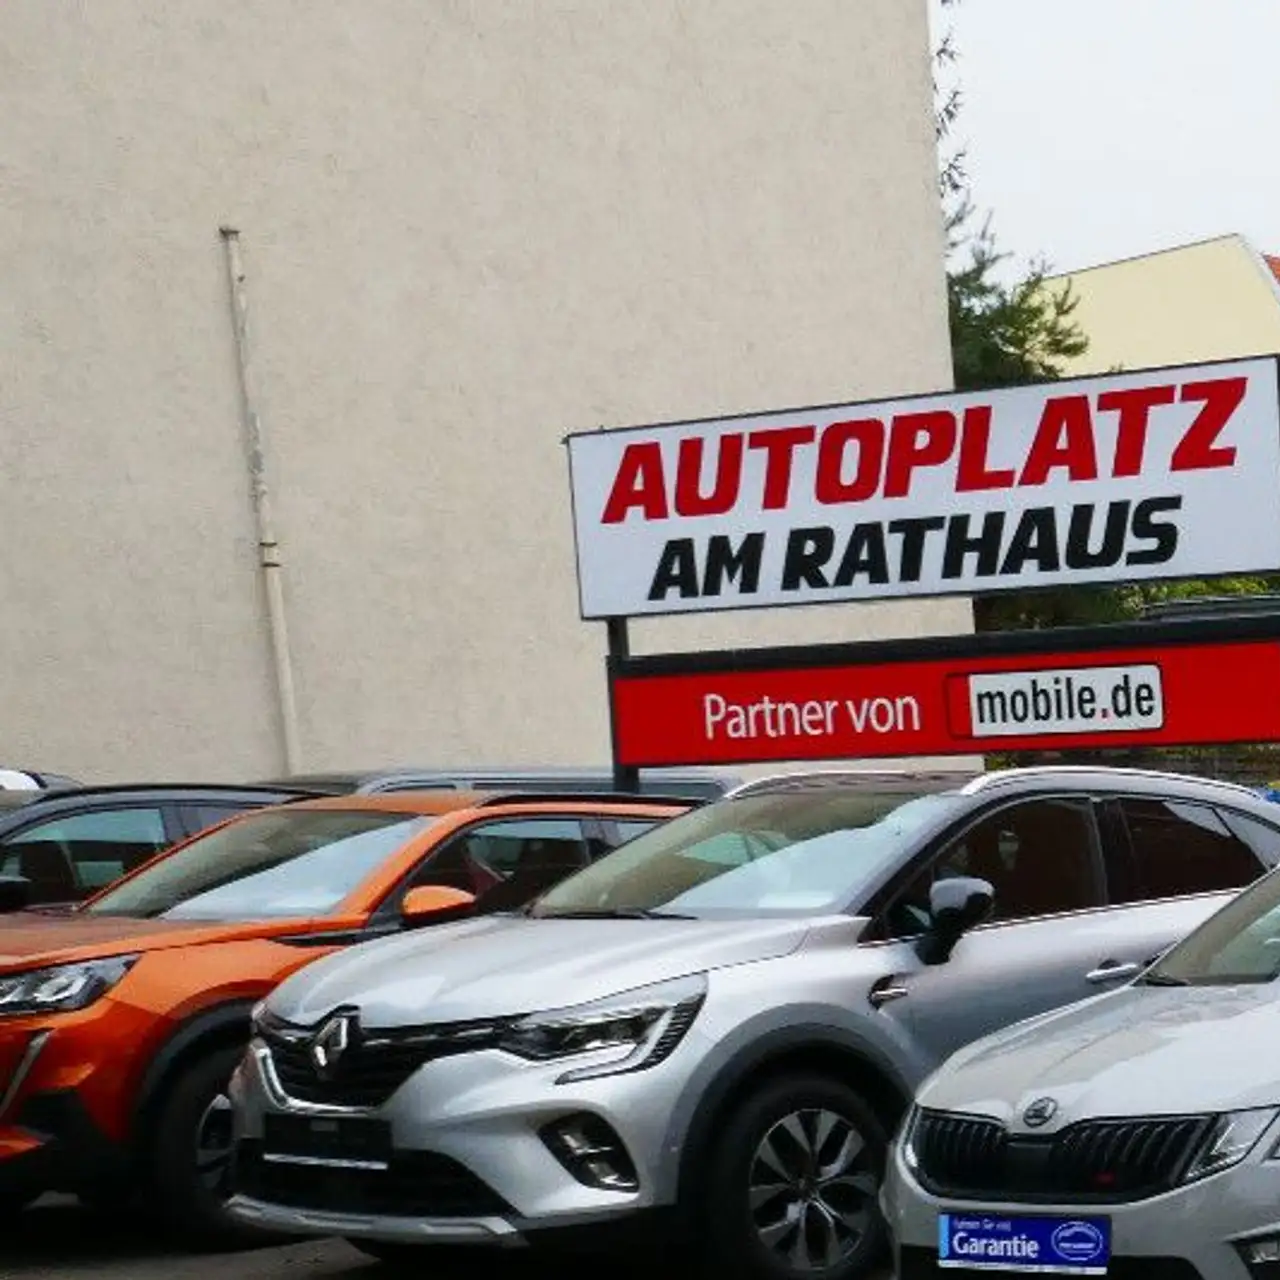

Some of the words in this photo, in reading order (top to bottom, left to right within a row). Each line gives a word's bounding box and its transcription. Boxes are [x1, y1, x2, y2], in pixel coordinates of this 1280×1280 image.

[602, 376, 1247, 525] AUTOPLATZ
[648, 531, 765, 601] AM
[781, 495, 1182, 592] RATHAUS
[703, 691, 835, 740] Partner
[845, 694, 920, 733] von
[976, 673, 1155, 723] mobile.de
[952, 1231, 1040, 1258] Garantie
